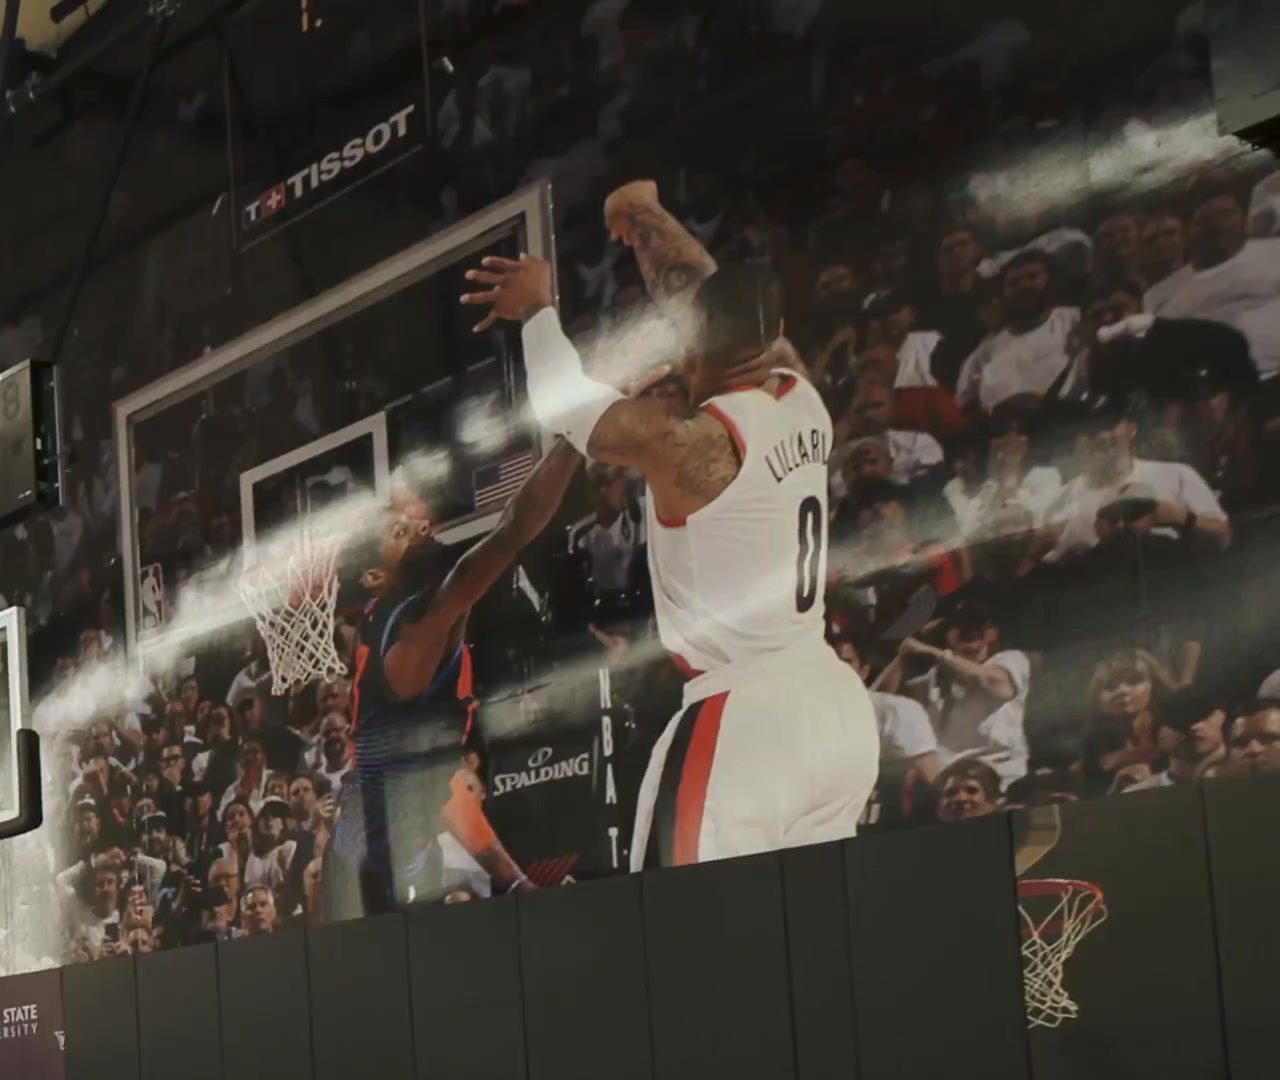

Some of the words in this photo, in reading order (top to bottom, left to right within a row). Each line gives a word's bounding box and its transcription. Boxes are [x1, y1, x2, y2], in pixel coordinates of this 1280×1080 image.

[286, 103, 415, 199] TISSOT
[796, 495, 822, 614] 0
[493, 752, 589, 796] SPALDING
[3, 1004, 38, 1024] STATE
